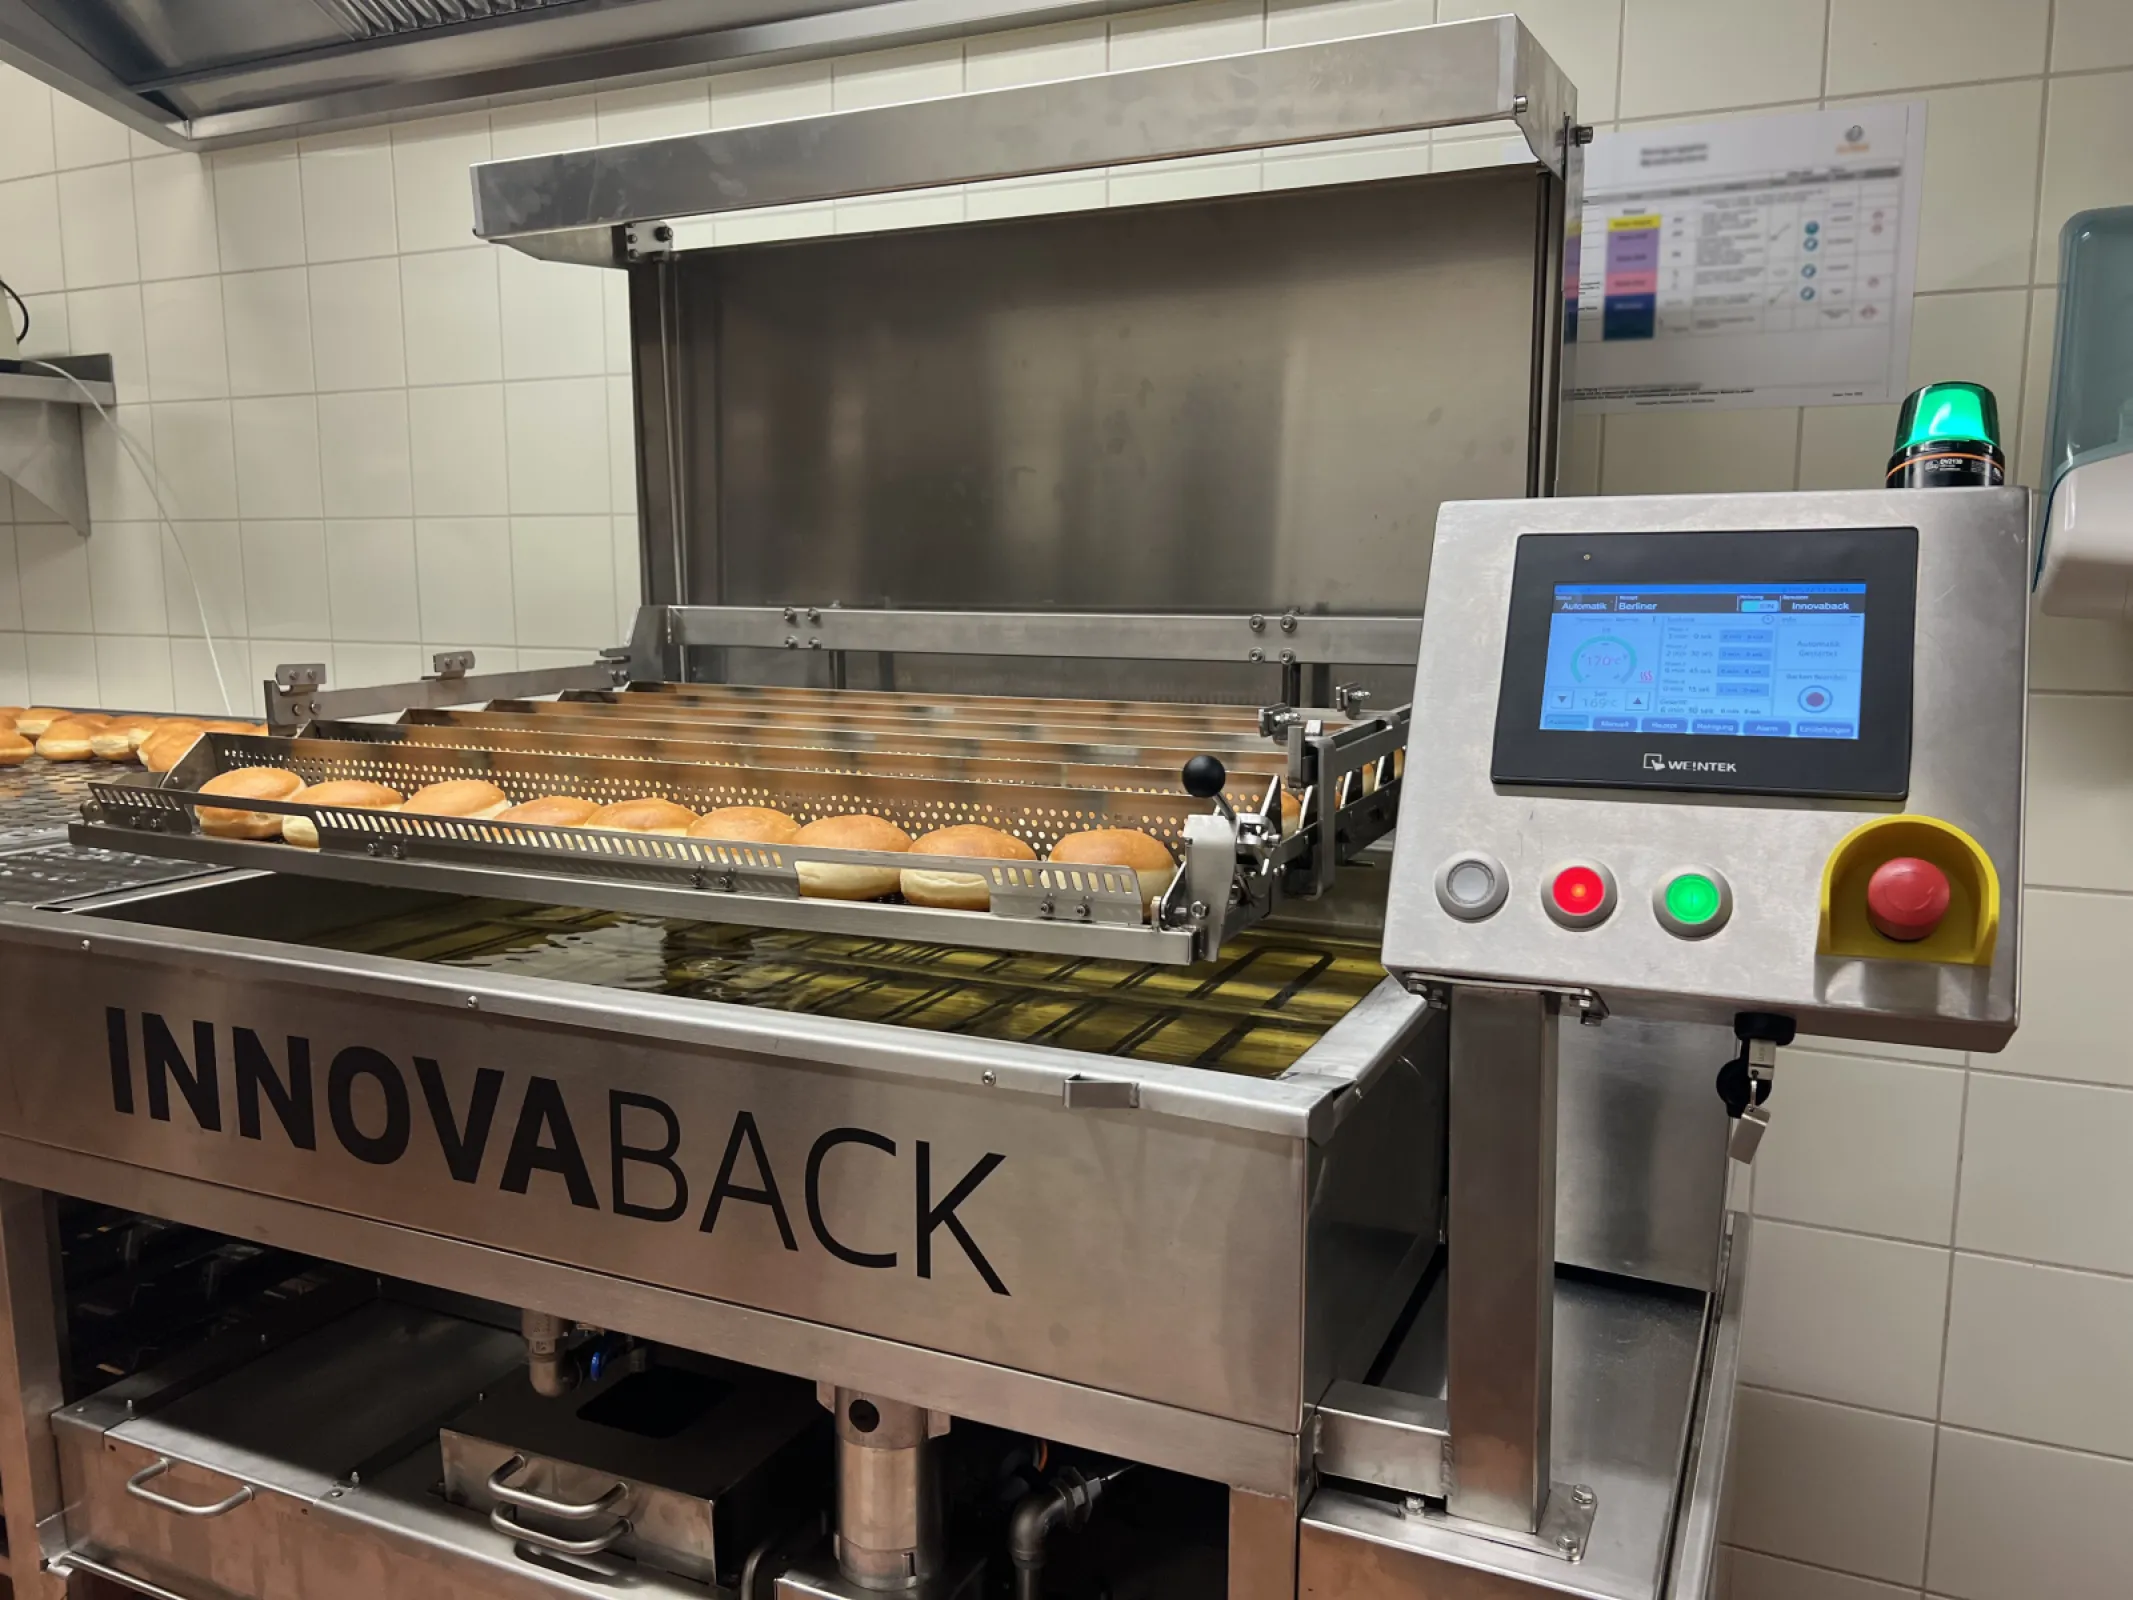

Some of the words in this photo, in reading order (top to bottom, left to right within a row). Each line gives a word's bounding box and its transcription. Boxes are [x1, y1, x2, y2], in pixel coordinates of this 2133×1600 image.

[1561, 602, 1607, 610] Automatik
[1619, 602, 1658, 610] Berliner
[1792, 602, 1850, 610] Innovaback
[105, 1006, 1011, 1297] INNOVABACK
